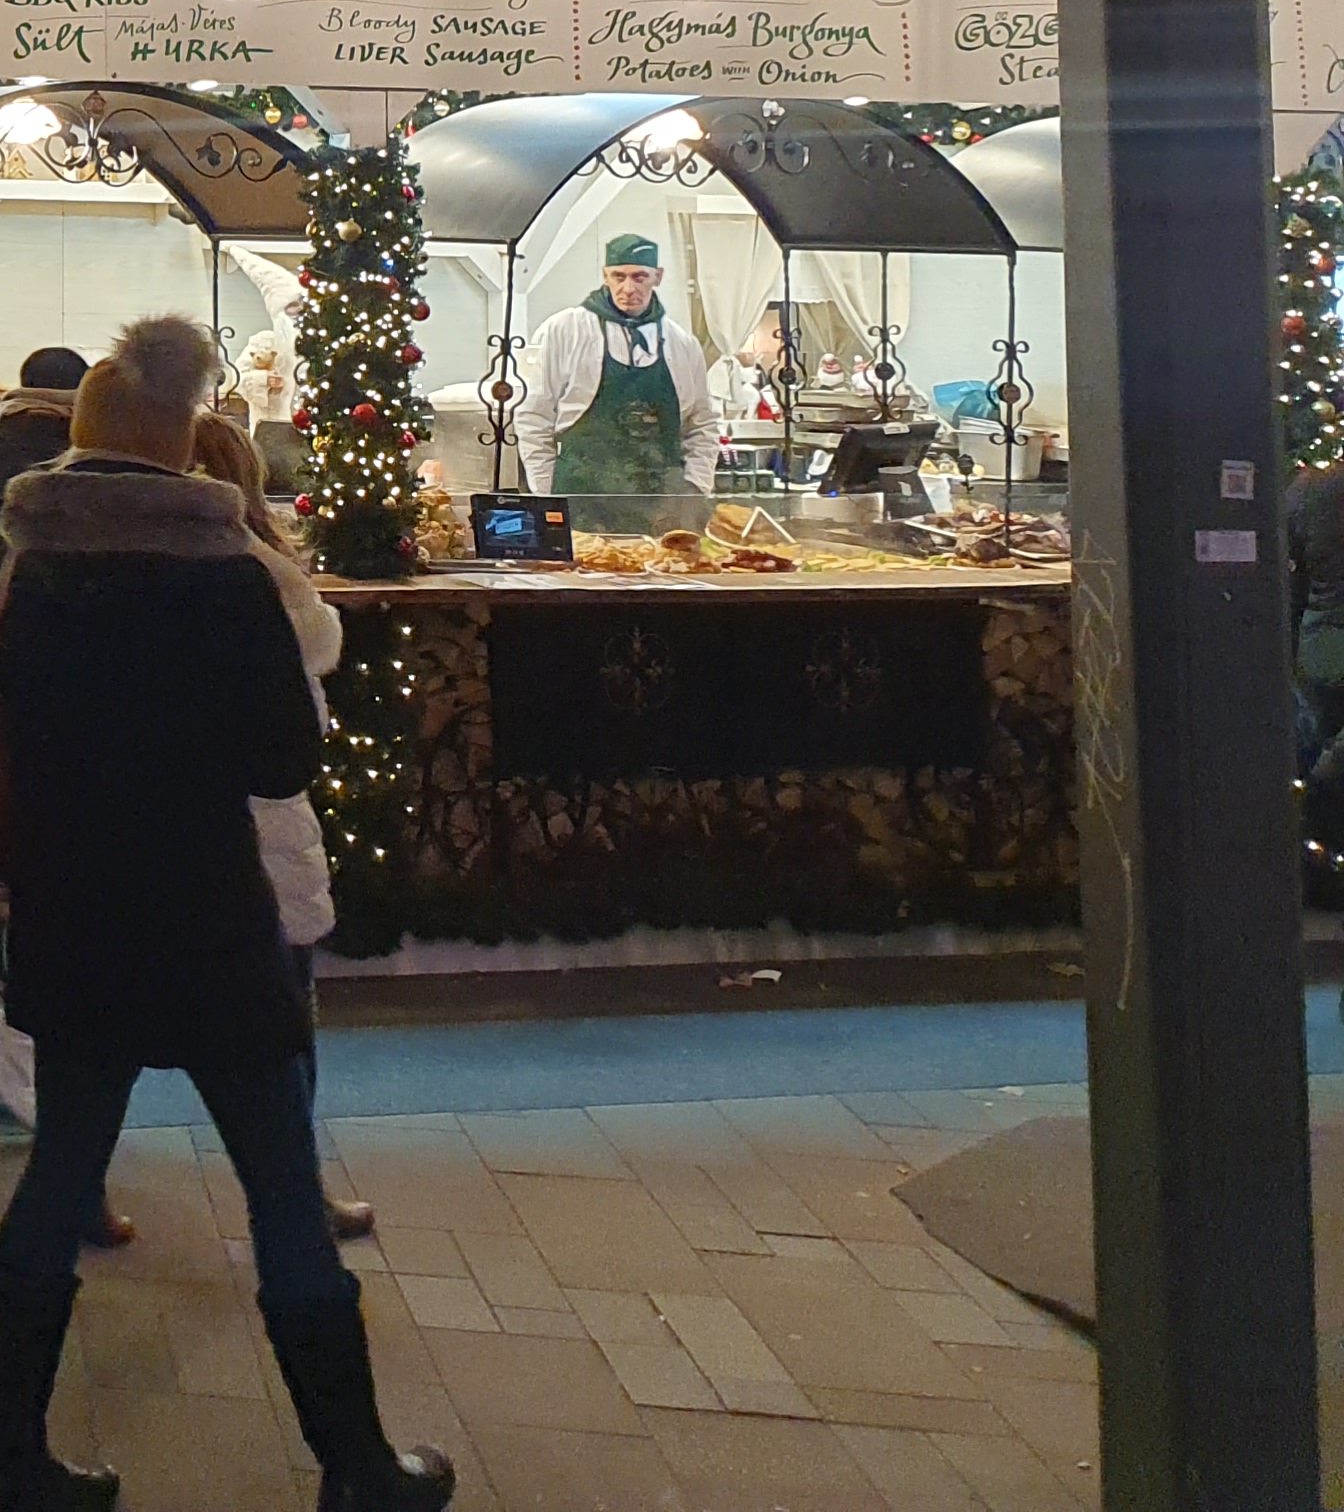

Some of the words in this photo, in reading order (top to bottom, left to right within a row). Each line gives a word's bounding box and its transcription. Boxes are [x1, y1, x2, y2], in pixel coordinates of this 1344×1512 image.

[13, 22, 105, 63] Sült
[318, 8, 416, 43] Bloody
[588, 9, 737, 52] Hagymás
[748, 12, 887, 60] Burgonya
[335, 44, 410, 64] LIVER
[424, 42, 564, 76] Sausage
[607, 56, 713, 84] Potatoes
[758, 59, 885, 85] Onion
